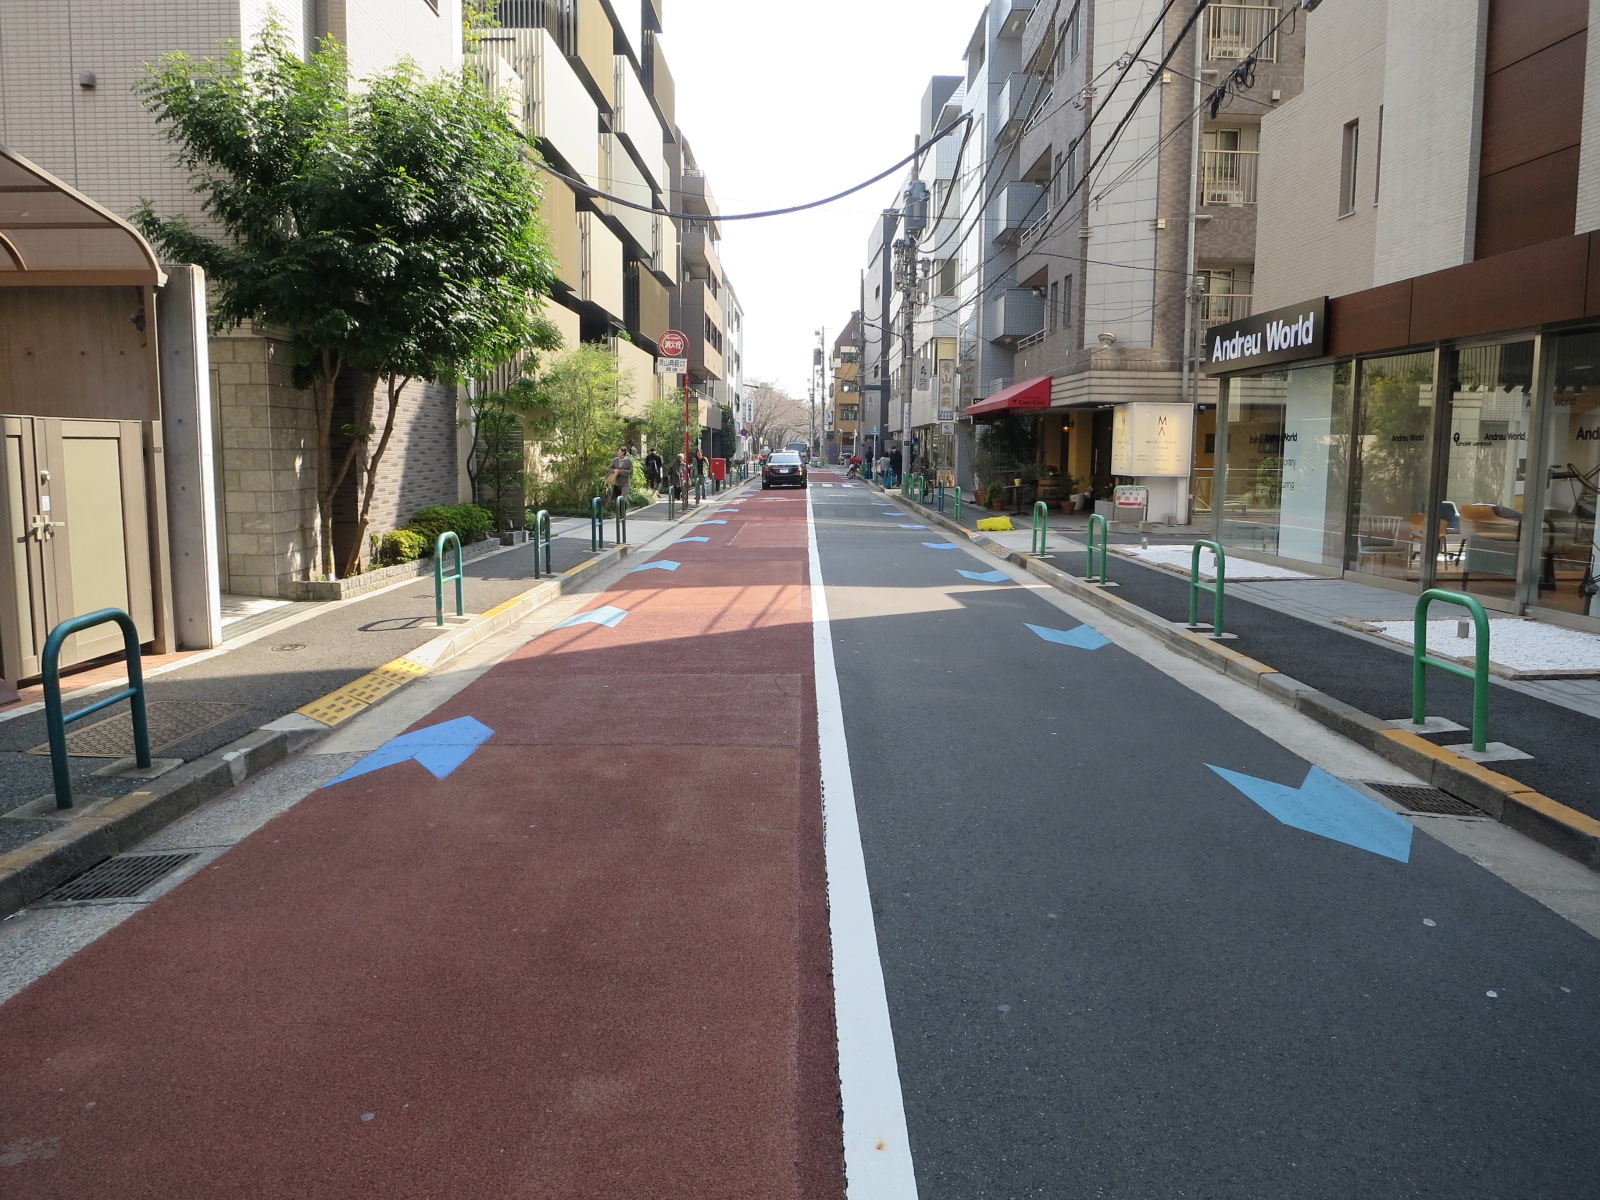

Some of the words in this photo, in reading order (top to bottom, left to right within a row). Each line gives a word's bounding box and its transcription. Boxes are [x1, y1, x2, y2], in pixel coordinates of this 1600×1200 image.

[1212, 331, 1261, 362] Andreu
[1266, 312, 1314, 352] World
[664, 340, 682, 349] 消火栓
[1484, 432, 1506, 441] Andreu
[1507, 431, 1526, 441] World
